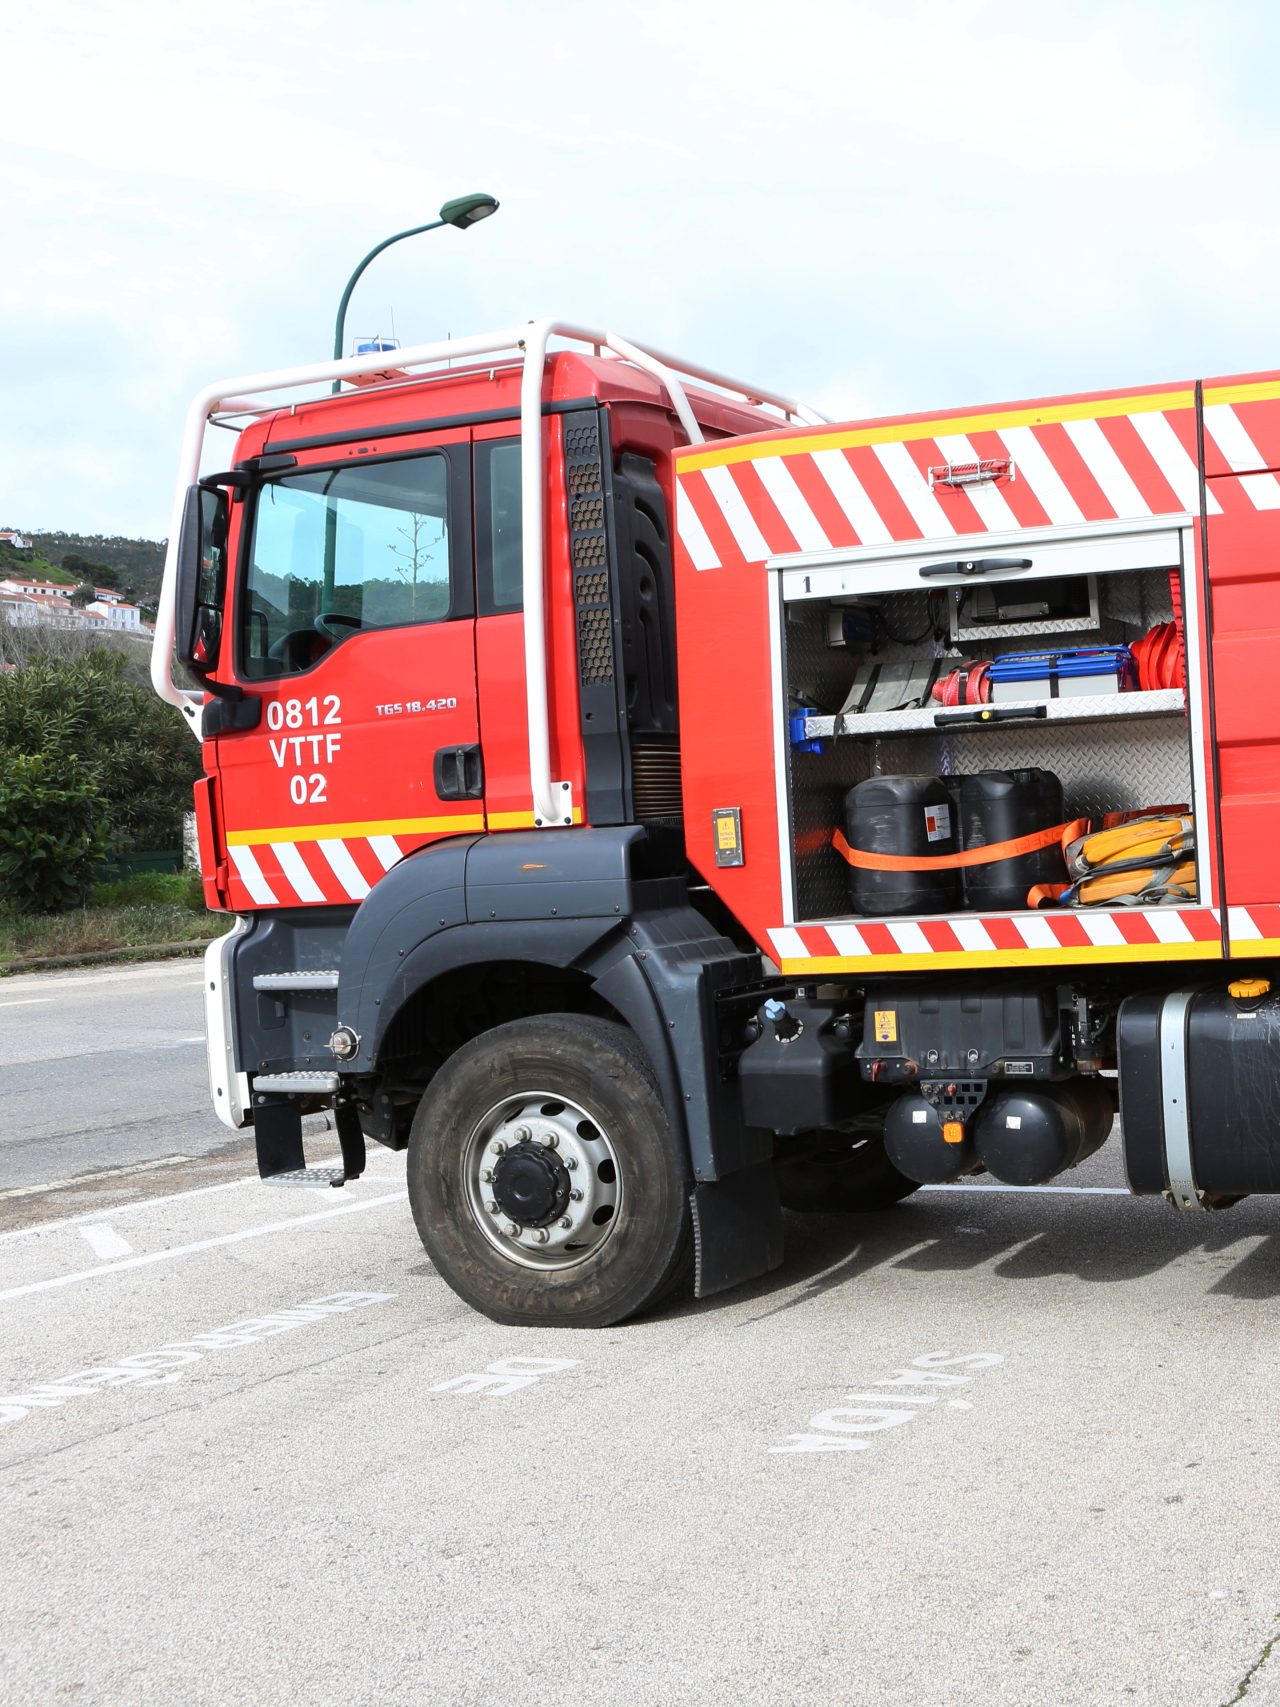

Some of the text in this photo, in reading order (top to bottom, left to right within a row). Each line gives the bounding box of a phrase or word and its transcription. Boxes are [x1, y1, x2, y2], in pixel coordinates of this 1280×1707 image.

[803, 576, 812, 593] 1
[267, 695, 342, 731] 0812
[376, 697, 457, 716] TGS 18.420
[269, 733, 342, 768] VTTF
[290, 773, 328, 805] 02
[429, 1356, 584, 1396] DE
[767, 1350, 1004, 1453] SAÍDA
